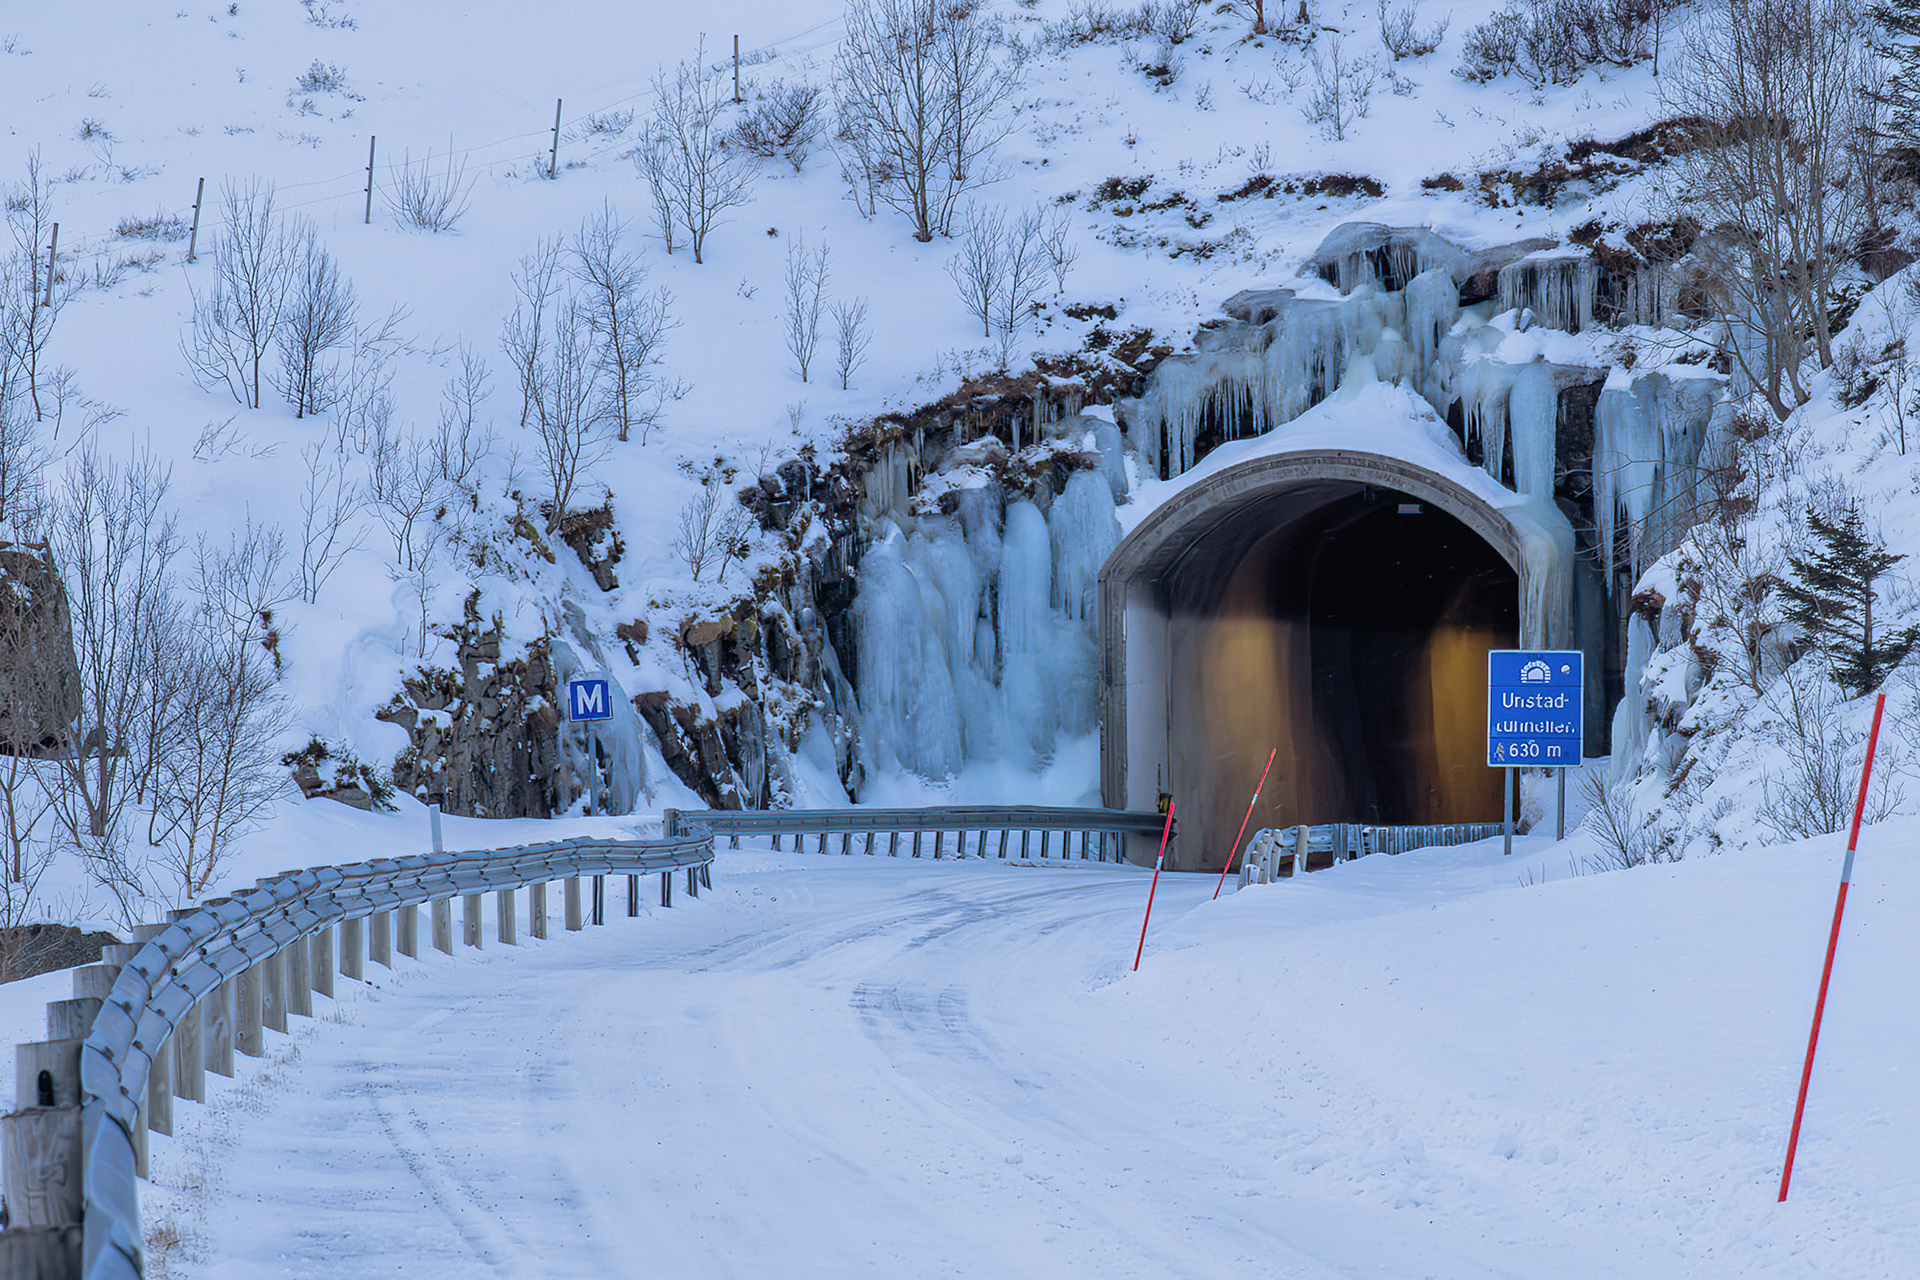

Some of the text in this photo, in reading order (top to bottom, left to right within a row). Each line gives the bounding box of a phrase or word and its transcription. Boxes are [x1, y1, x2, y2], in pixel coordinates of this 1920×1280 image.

[577, 684, 603, 715] M
[1509, 743, 1561, 757] 630 m
